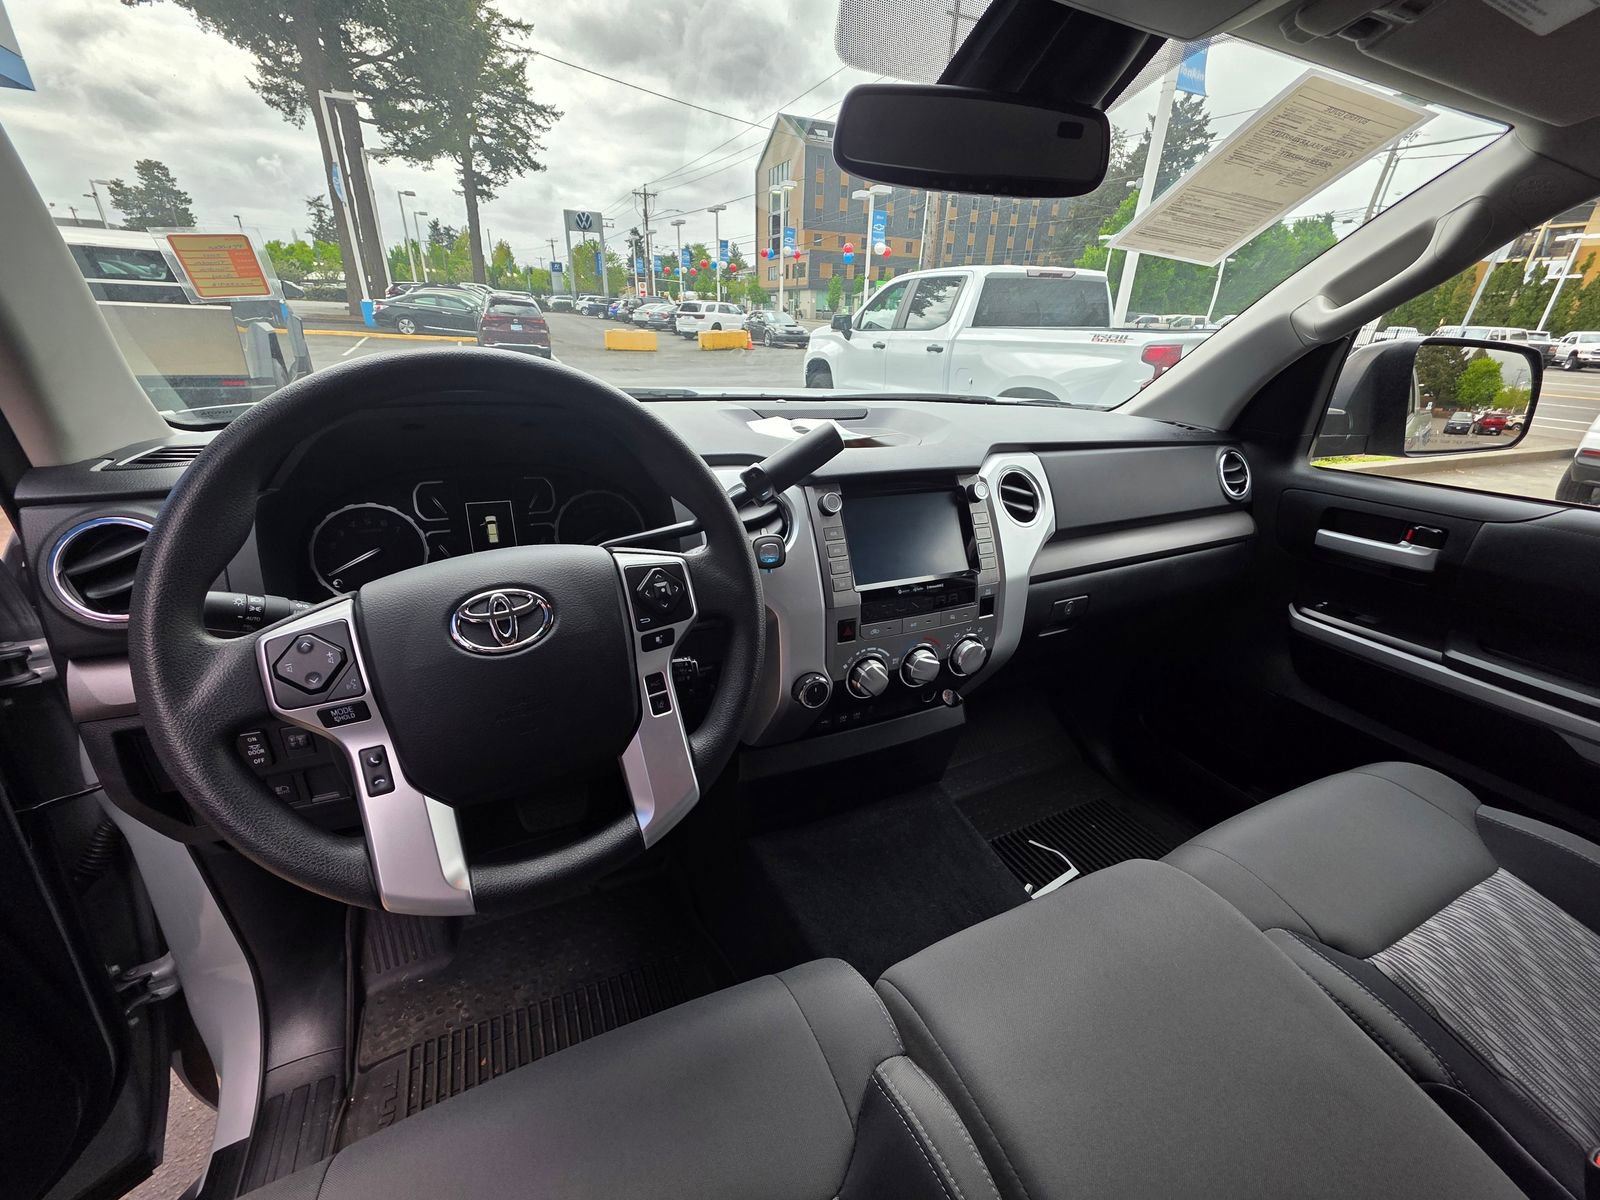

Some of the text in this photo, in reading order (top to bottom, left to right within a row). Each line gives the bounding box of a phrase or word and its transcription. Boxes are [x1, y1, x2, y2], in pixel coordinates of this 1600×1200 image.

[330, 705, 354, 717] MODE
[339, 712, 356, 721] HOLD
[247, 748, 265, 756] DOOR
[253, 757, 265, 765] OFF
